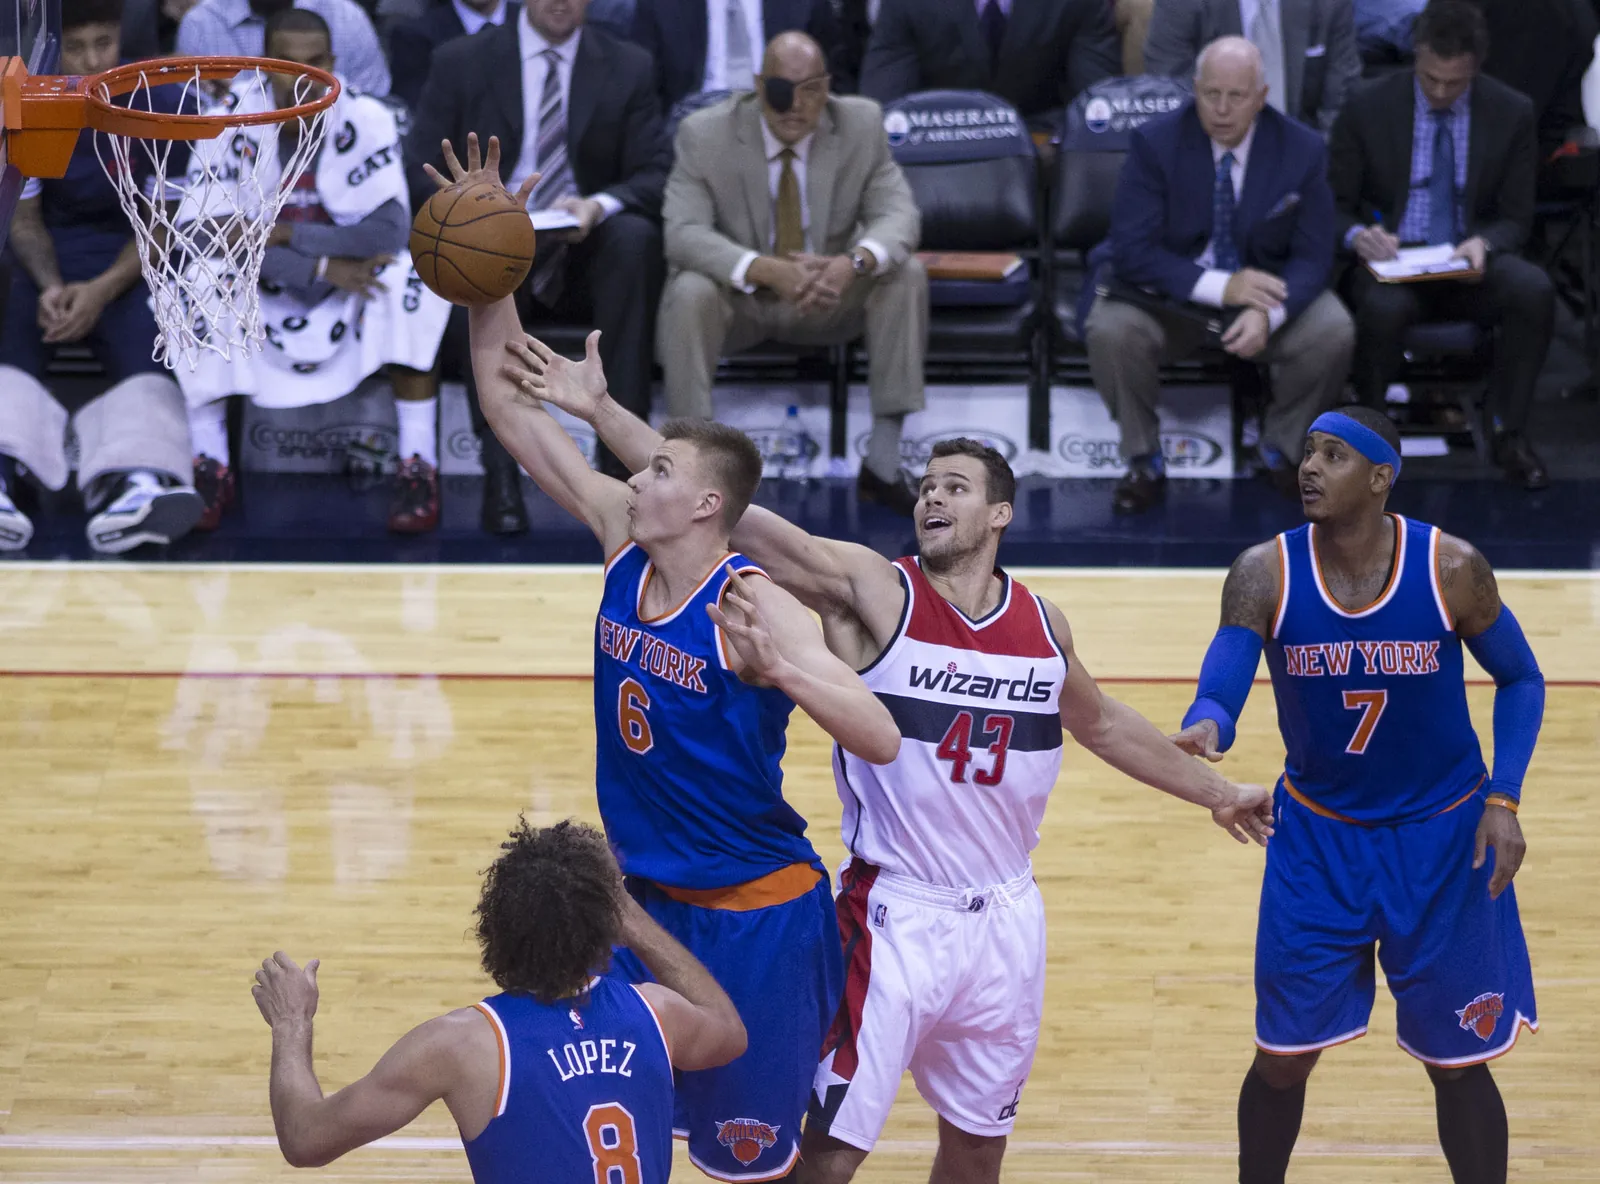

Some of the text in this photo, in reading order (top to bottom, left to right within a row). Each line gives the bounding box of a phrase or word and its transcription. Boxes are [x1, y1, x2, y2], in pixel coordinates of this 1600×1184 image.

[925, 124, 1020, 142] ARLINGTON
[1111, 96, 1181, 114] MASER
[640, 631, 708, 694] YORK
[1284, 640, 1441, 677] NEW YORK
[617, 676, 654, 756] 6
[1341, 688, 1388, 755] 7
[935, 710, 1015, 787] 43
[547, 1038, 637, 1082] LOPEZ
[582, 1101, 644, 1184] 8
